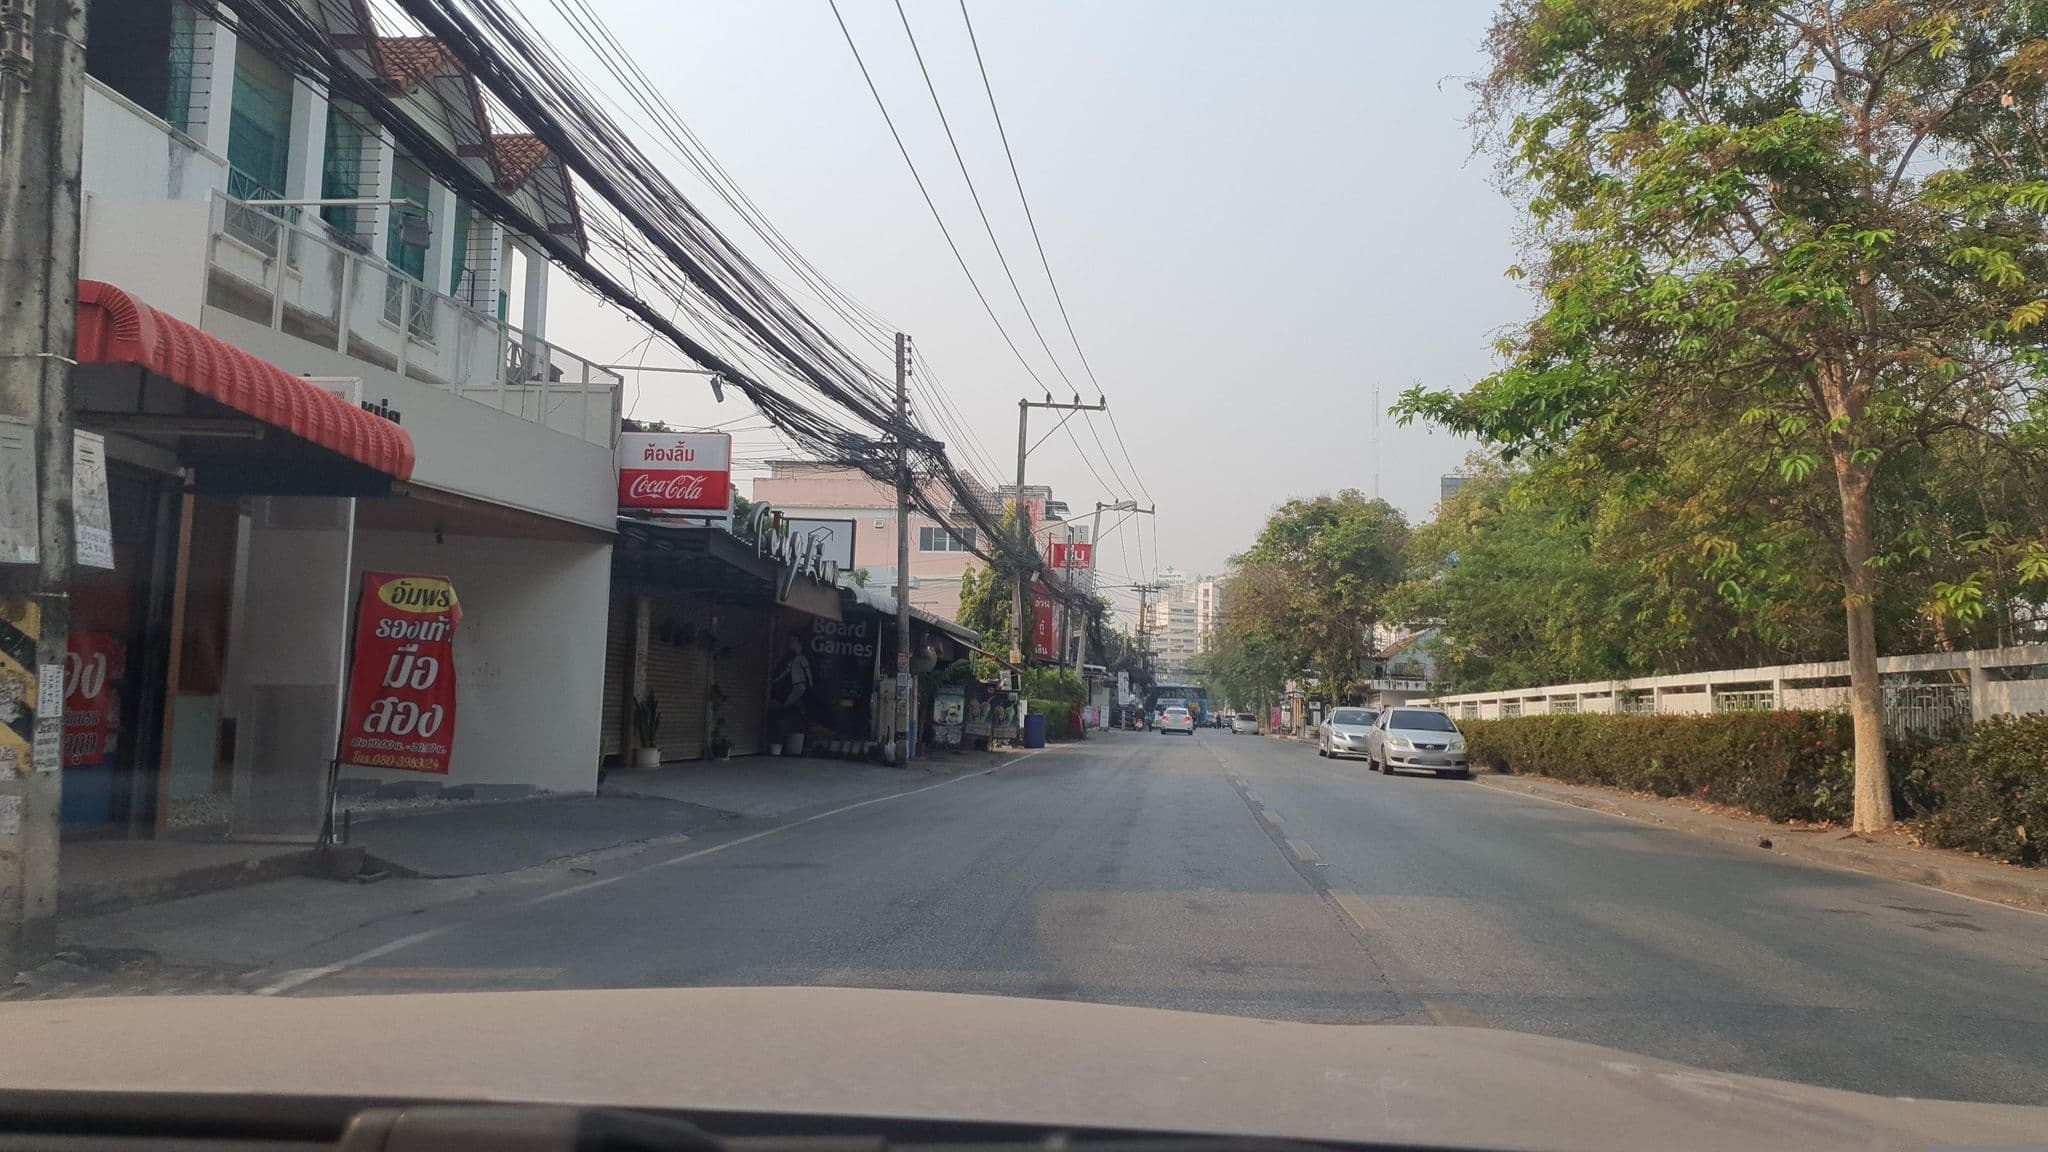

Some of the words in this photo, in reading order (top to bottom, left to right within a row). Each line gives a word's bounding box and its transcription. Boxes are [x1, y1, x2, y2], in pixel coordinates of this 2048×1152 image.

[644, 440, 695, 462] ต้องลิ้ม
[630, 474, 708, 500] Coca-Cola
[391, 580, 450, 608] อัมพร
[814, 616, 867, 638] Board
[811, 635, 873, 657] Games
[64, 651, 106, 699] อง
[383, 642, 439, 690] มือ
[363, 696, 445, 738] สอง
